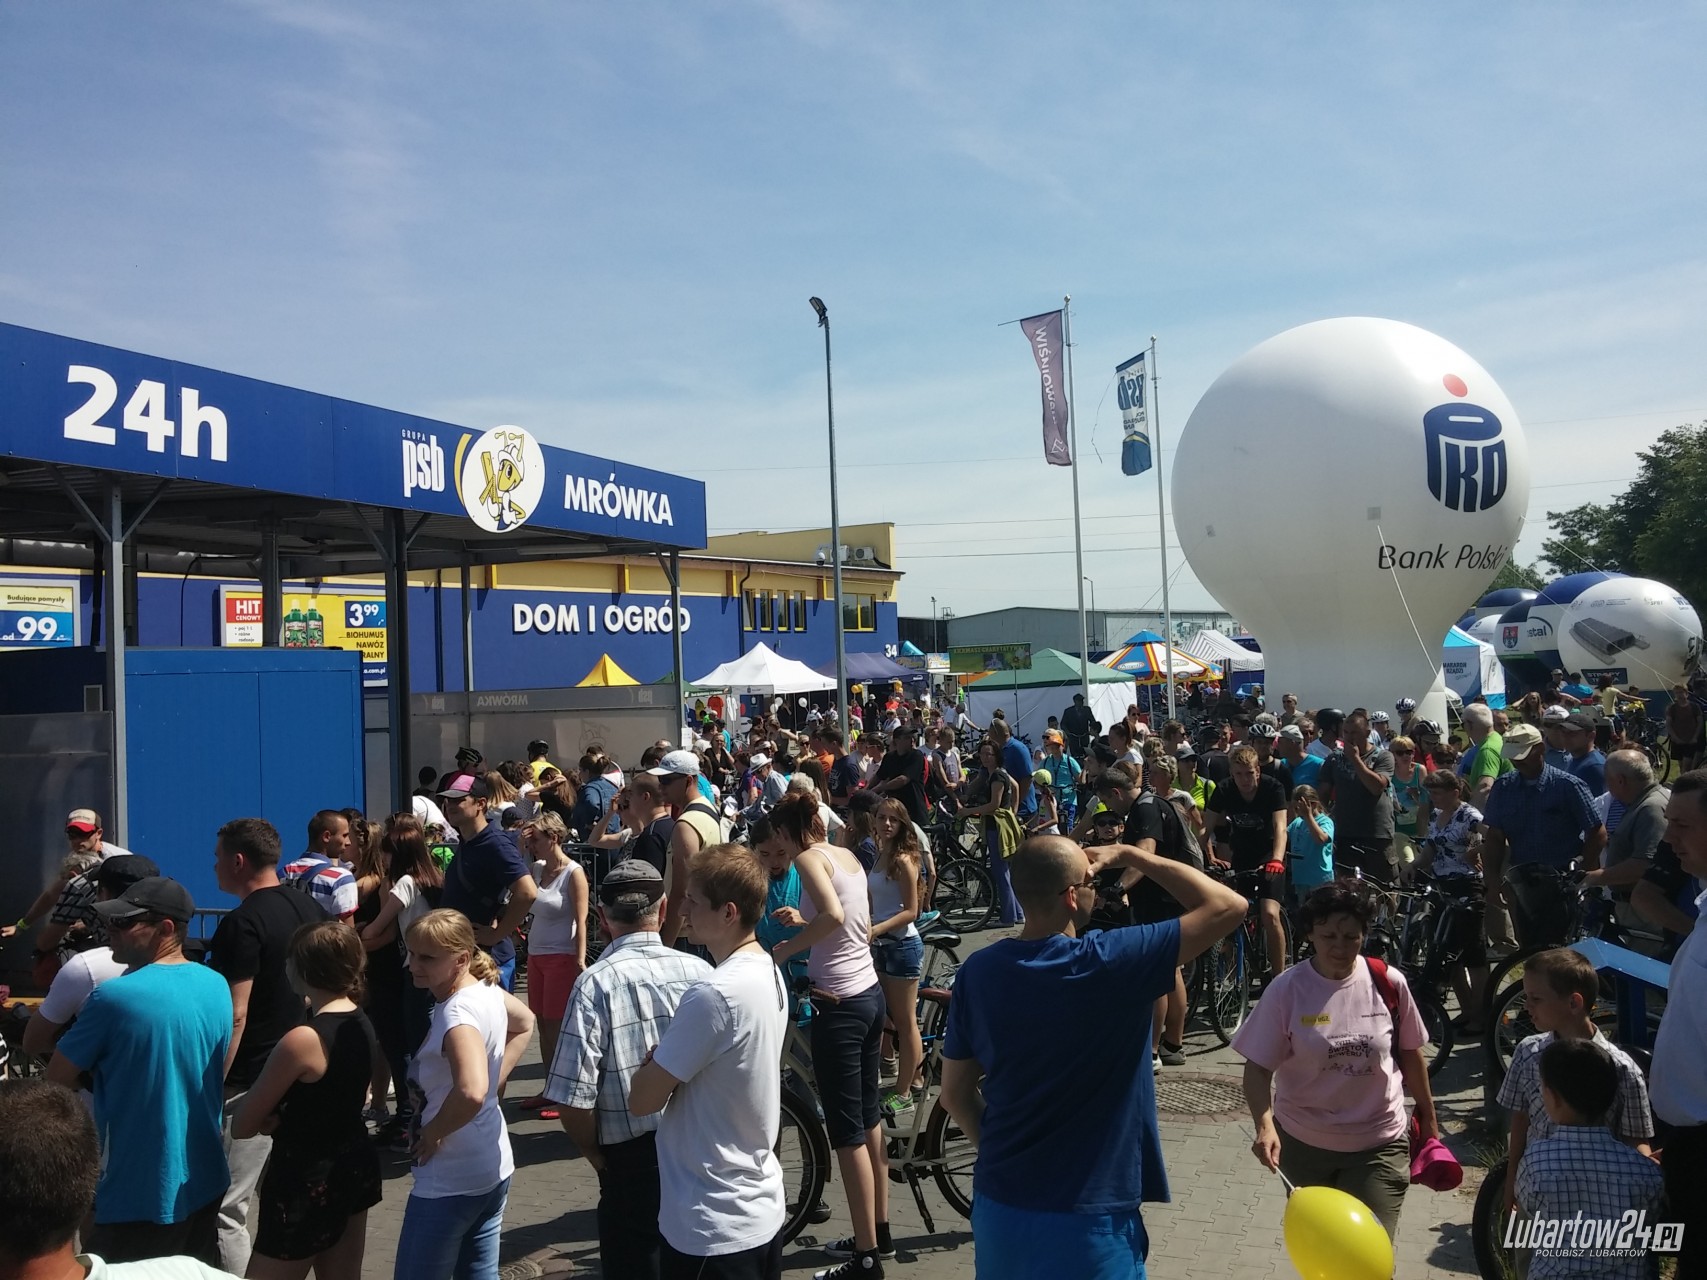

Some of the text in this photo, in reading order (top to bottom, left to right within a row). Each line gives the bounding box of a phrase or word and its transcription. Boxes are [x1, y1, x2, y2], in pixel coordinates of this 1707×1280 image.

[63, 365, 228, 462] 24h
[402, 428, 427, 442] GRUPA
[1423, 402, 1507, 512] PKO
[402, 434, 445, 498] psb
[563, 472, 674, 527] MRÓWKA
[1379, 543, 1508, 571] Bank Polski
[7, 594, 65, 604] Budujące pomysły
[236, 600, 261, 615] HIT
[513, 602, 581, 635] DOM
[588, 605, 598, 634] I
[2, 632, 15, 641] od
[346, 631, 384, 639] BIOHUMUS
[1527, 625, 1547, 637] stal
[356, 640, 385, 649] NAWÓZ
[885, 644, 898, 658] 34
[362, 651, 385, 659] RALNY
[363, 667, 386, 675] a.com.pl
